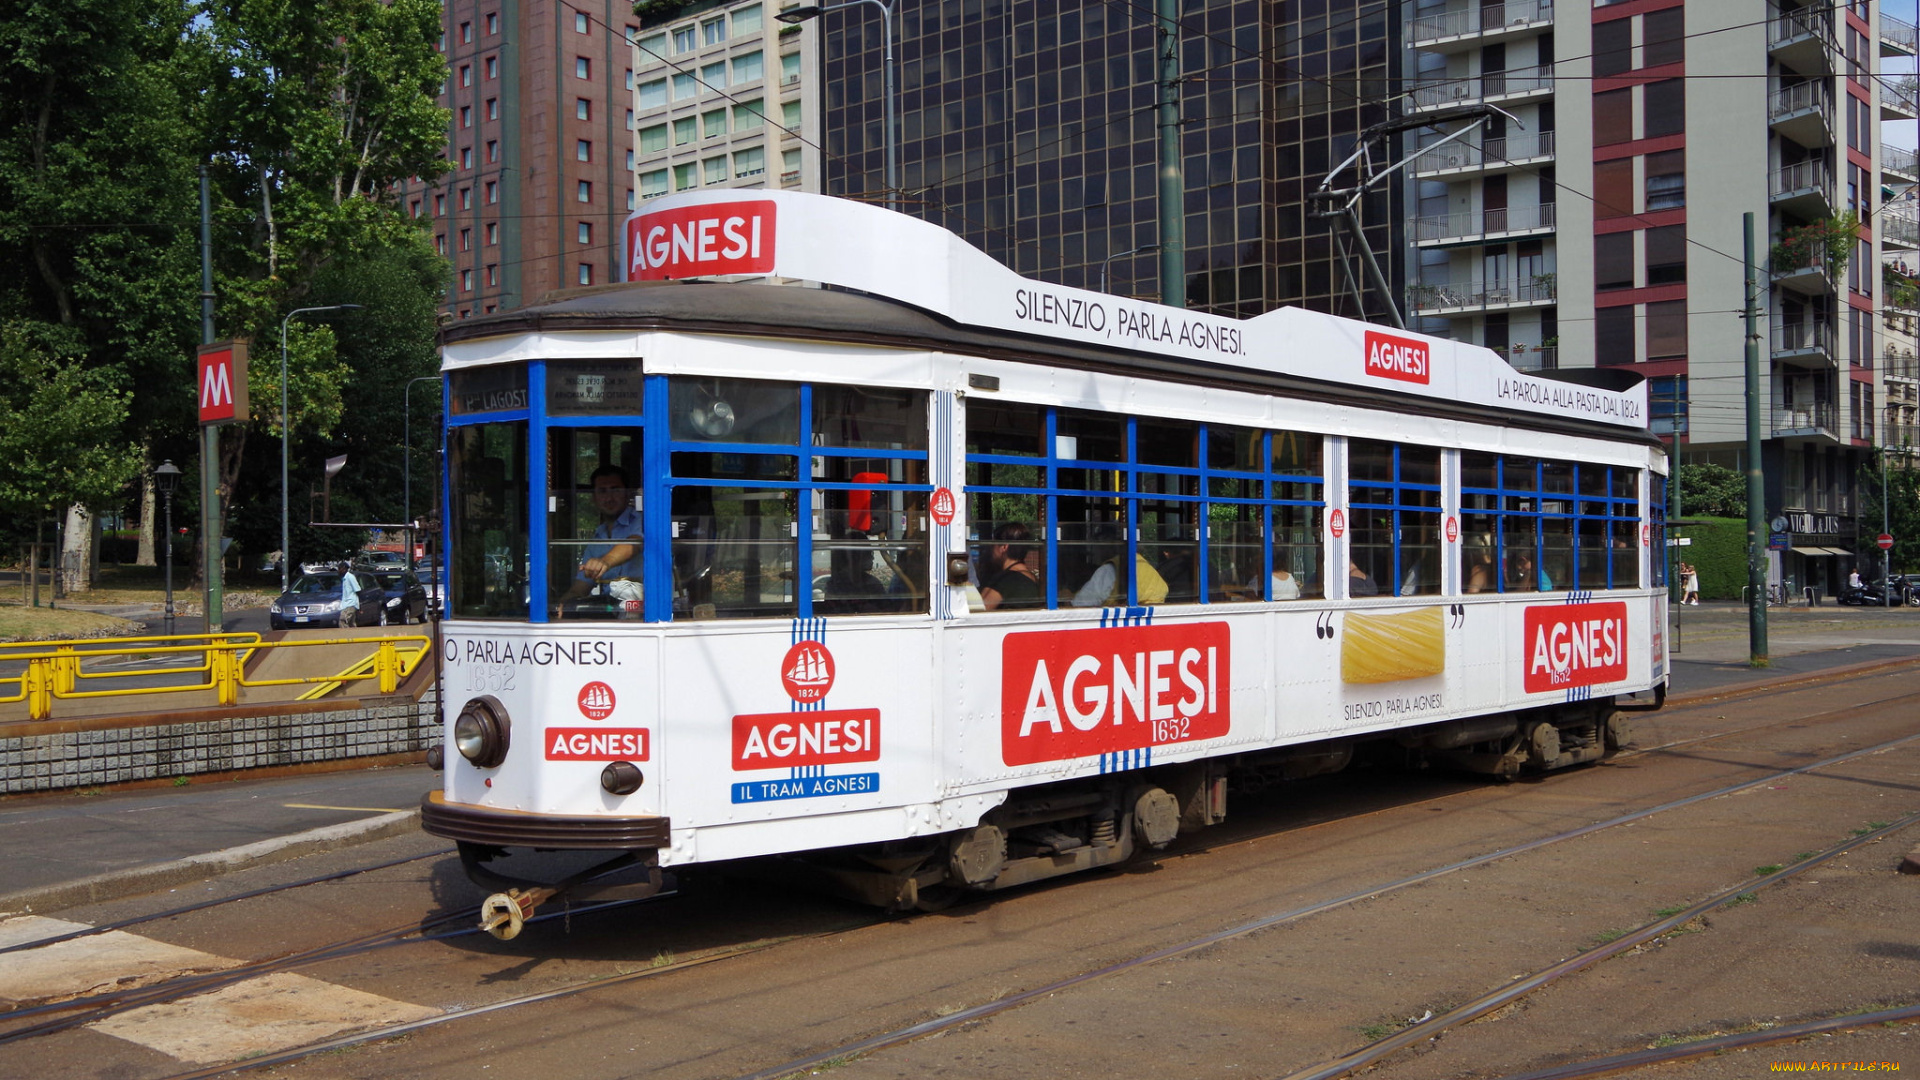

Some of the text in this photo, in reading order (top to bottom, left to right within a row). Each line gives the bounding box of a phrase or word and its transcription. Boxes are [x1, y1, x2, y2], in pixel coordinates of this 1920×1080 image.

[631, 215, 761, 273] AGNESI
[1015, 289, 1246, 356] SILENZIO, PARLA AGNESI.
[1369, 340, 1425, 376] AGNESI
[202, 362, 232, 408] M
[1497, 377, 1639, 419] LA PAROLA ALLA PASTA DAL 1824
[467, 640, 515, 664] PARLA
[519, 641, 621, 666] AGNESI.
[1531, 618, 1622, 675] AGNESI
[466, 665, 516, 691] 1652
[1550, 667, 1571, 684] 1652
[798, 689, 819, 698] 1824
[1019, 646, 1217, 737] AGNESI
[1344, 694, 1444, 720] SILENZIO, PARLA AGNESI.
[551, 734, 643, 755] AGNESI
[741, 719, 871, 759] AGNESI
[1152, 717, 1190, 742] 1652
[741, 776, 871, 800] IL TRAM AGNESI
